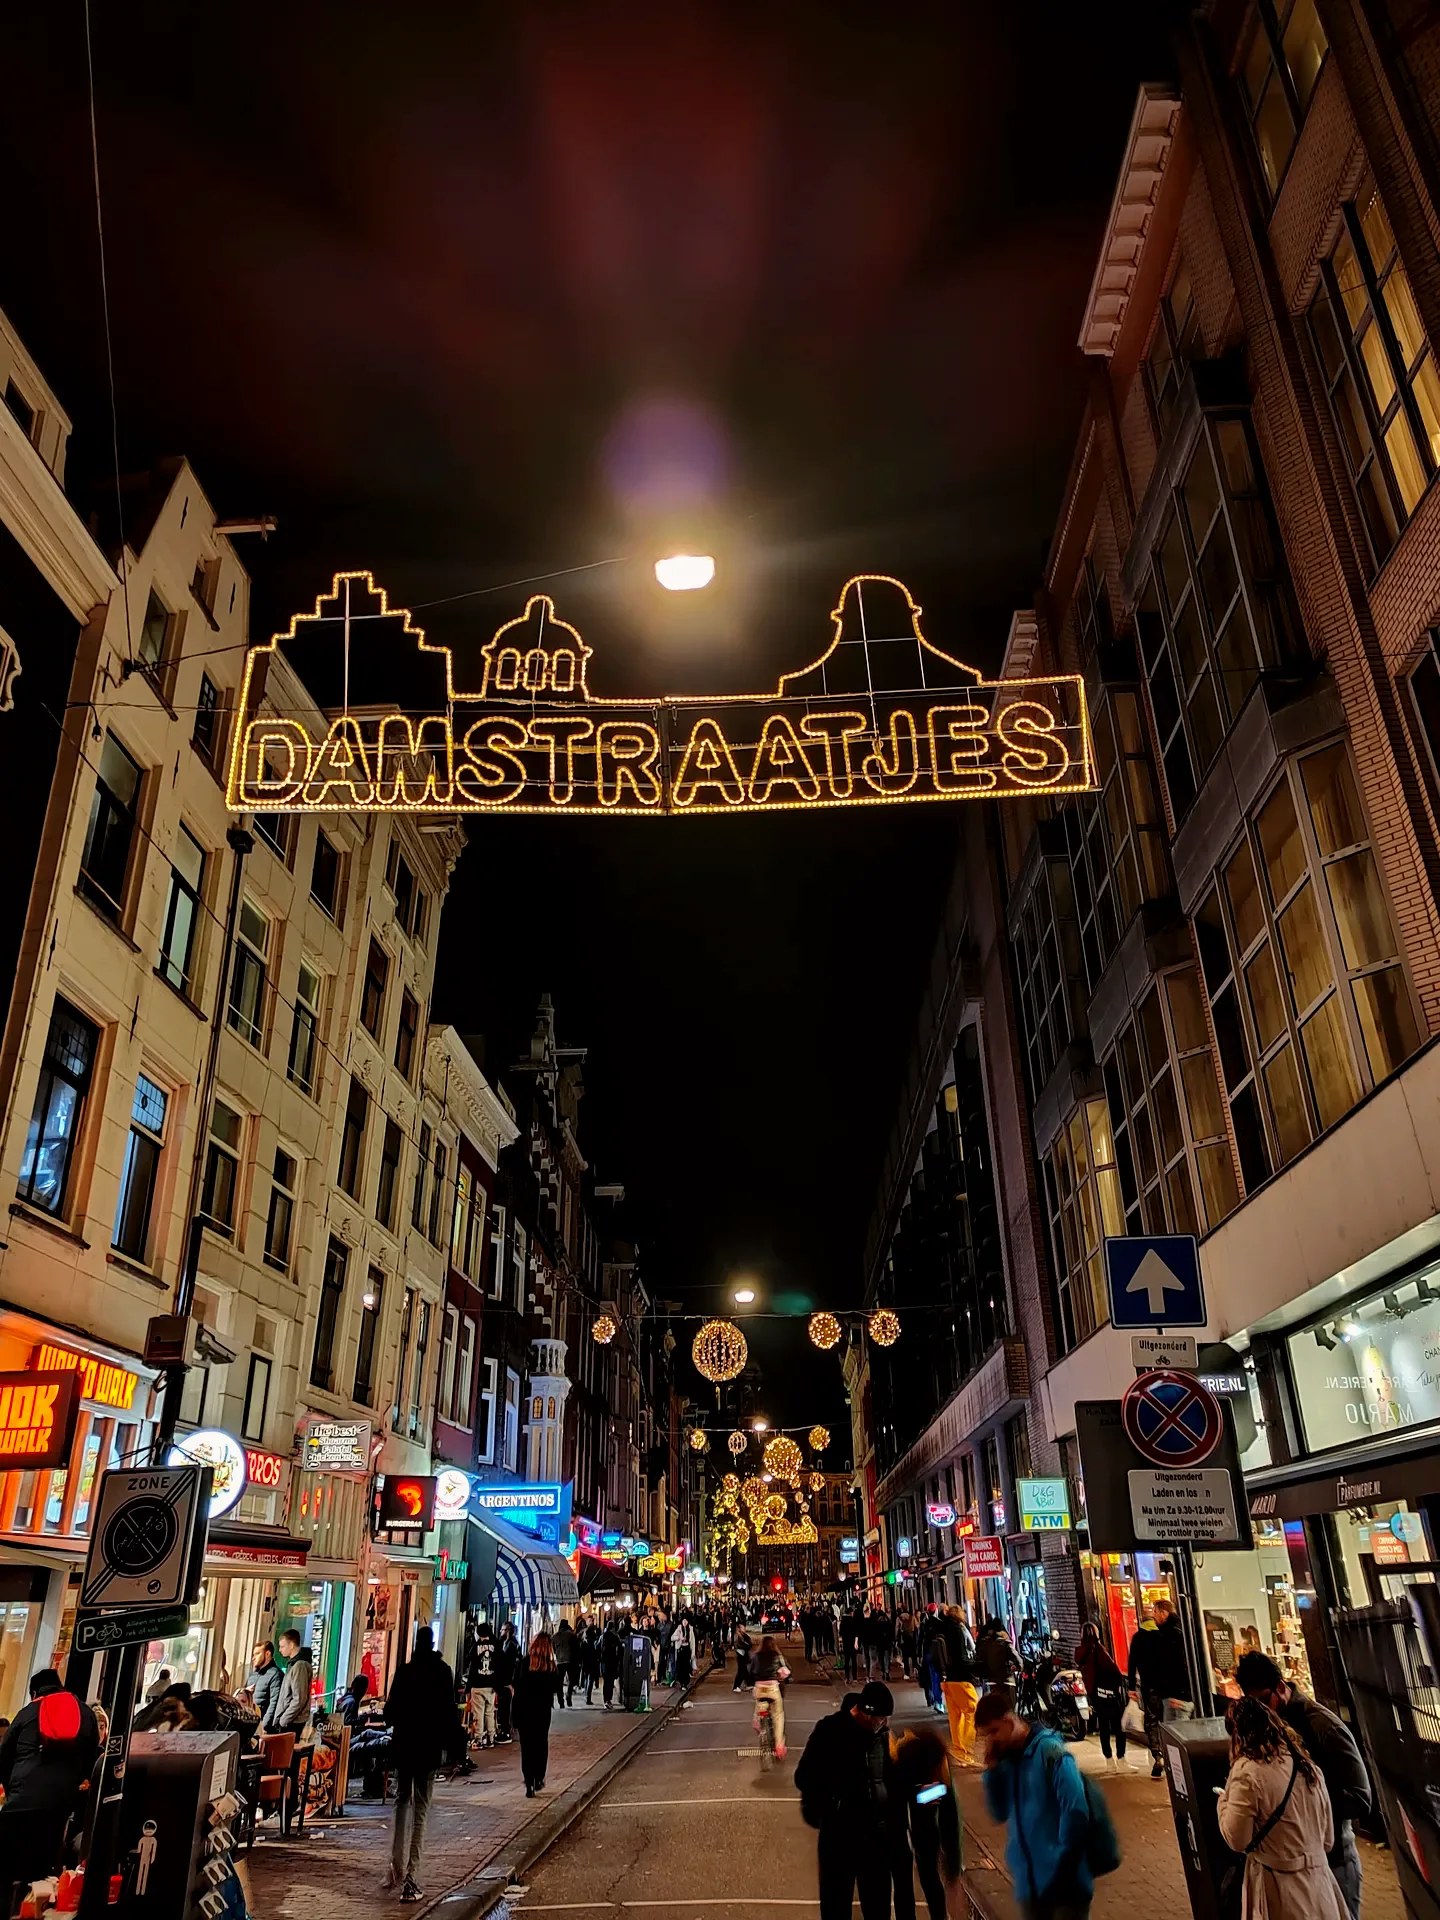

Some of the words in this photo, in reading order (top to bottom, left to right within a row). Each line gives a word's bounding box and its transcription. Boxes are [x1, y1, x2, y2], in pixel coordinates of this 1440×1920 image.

[239, 700, 1070, 806] DAMSTRAATJES
[1139, 1340, 1187, 1351] Uitgezonderd
[94, 1364, 138, 1410] WALK
[310, 1425, 331, 1437] The
[333, 1424, 357, 1437] best
[319, 1437, 357, 1445] Shoarma
[321, 1445, 352, 1454] Falafel
[306, 1453, 365, 1461] Chickenkebab
[1154, 1473, 1203, 1483] Uitgezonderd
[128, 1476, 171, 1491] ZONE
[1032, 1485, 1055, 1498] D&G
[1152, 1488, 1175, 1498] Laden
[1176, 1489, 1185, 1498] en
[1340, 1481, 1382, 1501] PARFUMERIE.NL
[478, 1494, 555, 1508] ARGENTINOS
[1142, 1506, 1153, 1515] Ma
[1167, 1506, 1176, 1515] Za
[386, 1520, 423, 1528] BURGERBAR
[1031, 1516, 1064, 1528] ATM
[1148, 1518, 1180, 1527] Minimaal
[1181, 1519, 1198, 1527] twee
[1199, 1518, 1223, 1527] wielen
[1156, 1530, 1166, 1538] op
[1167, 1528, 1192, 1537] trottoir
[1194, 1530, 1217, 1538] graag.
[971, 1541, 992, 1550] DRINKS
[969, 1552, 979, 1562] SIM
[980, 1551, 998, 1561] CARDS
[969, 1562, 1001, 1572] SOUVENIRS
[125, 1618, 148, 1628] Alleen
[82, 1625, 96, 1645] P
[125, 1629, 136, 1637] rek
[316, 1722, 342, 1732] Coffee
